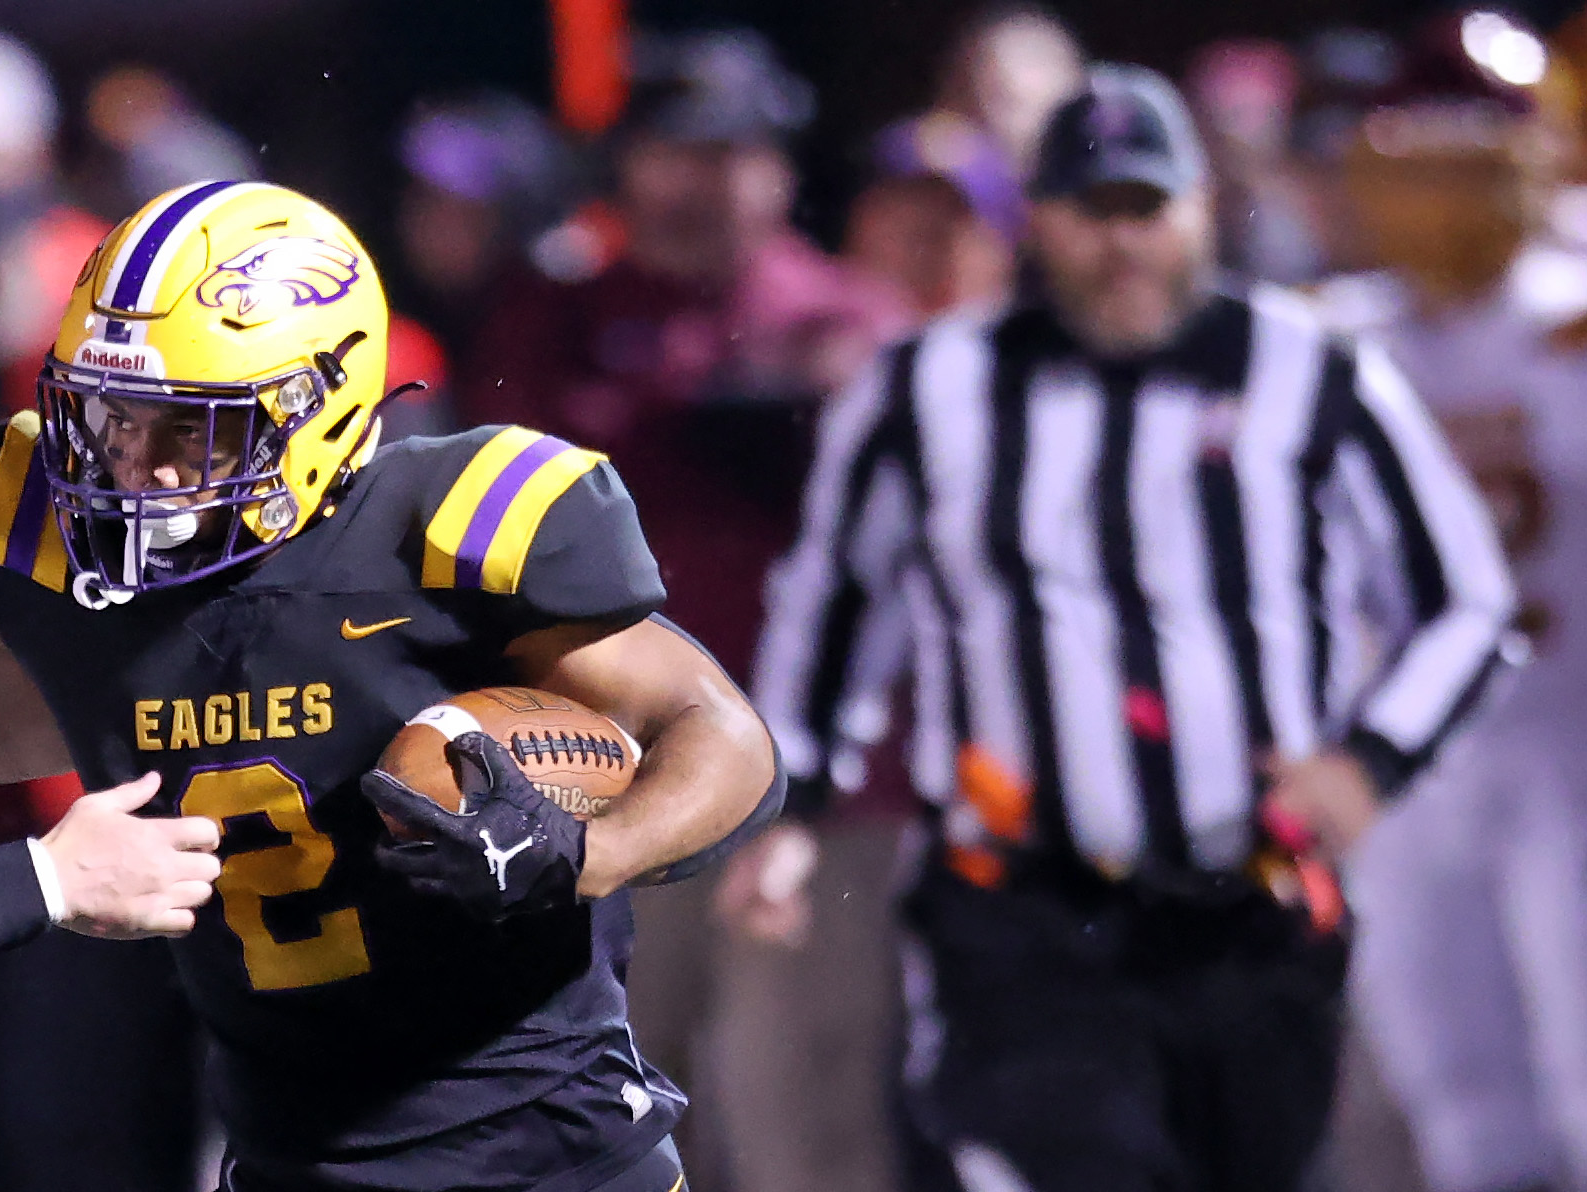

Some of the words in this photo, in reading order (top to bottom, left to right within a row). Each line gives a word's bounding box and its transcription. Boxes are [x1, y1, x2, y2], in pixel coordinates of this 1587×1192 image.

[80, 347, 146, 370] Riddell
[135, 683, 334, 752] EAGLES
[532, 782, 610, 815] Wilso
[175, 755, 372, 991] 2
